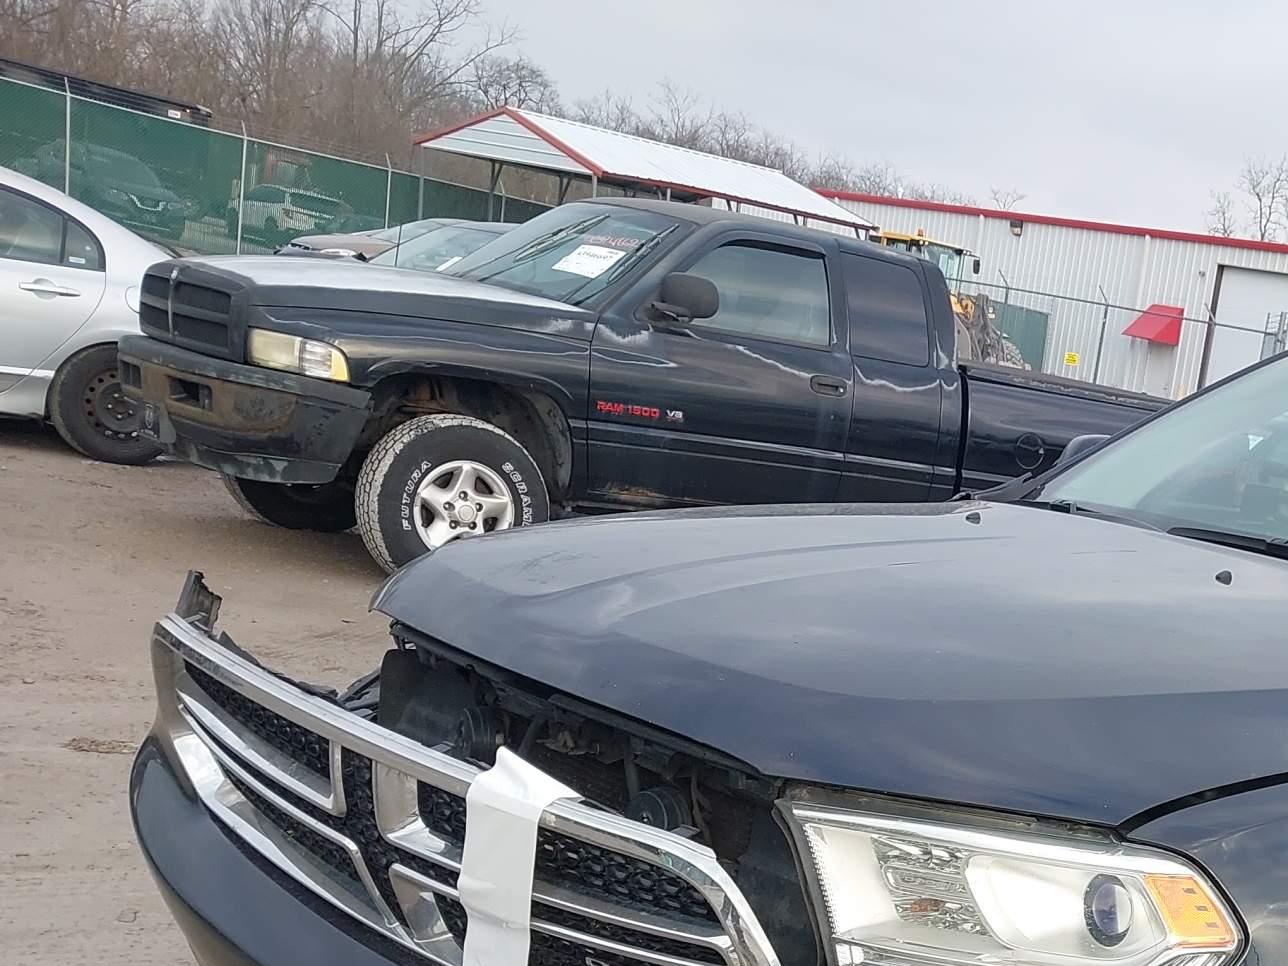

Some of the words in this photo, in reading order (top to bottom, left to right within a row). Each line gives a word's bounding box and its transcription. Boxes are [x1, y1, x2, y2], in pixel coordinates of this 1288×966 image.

[596, 400, 624, 414] RAM
[628, 404, 660, 418] 1500
[665, 409, 683, 419] V8
[401, 460, 431, 530] FUTURA
